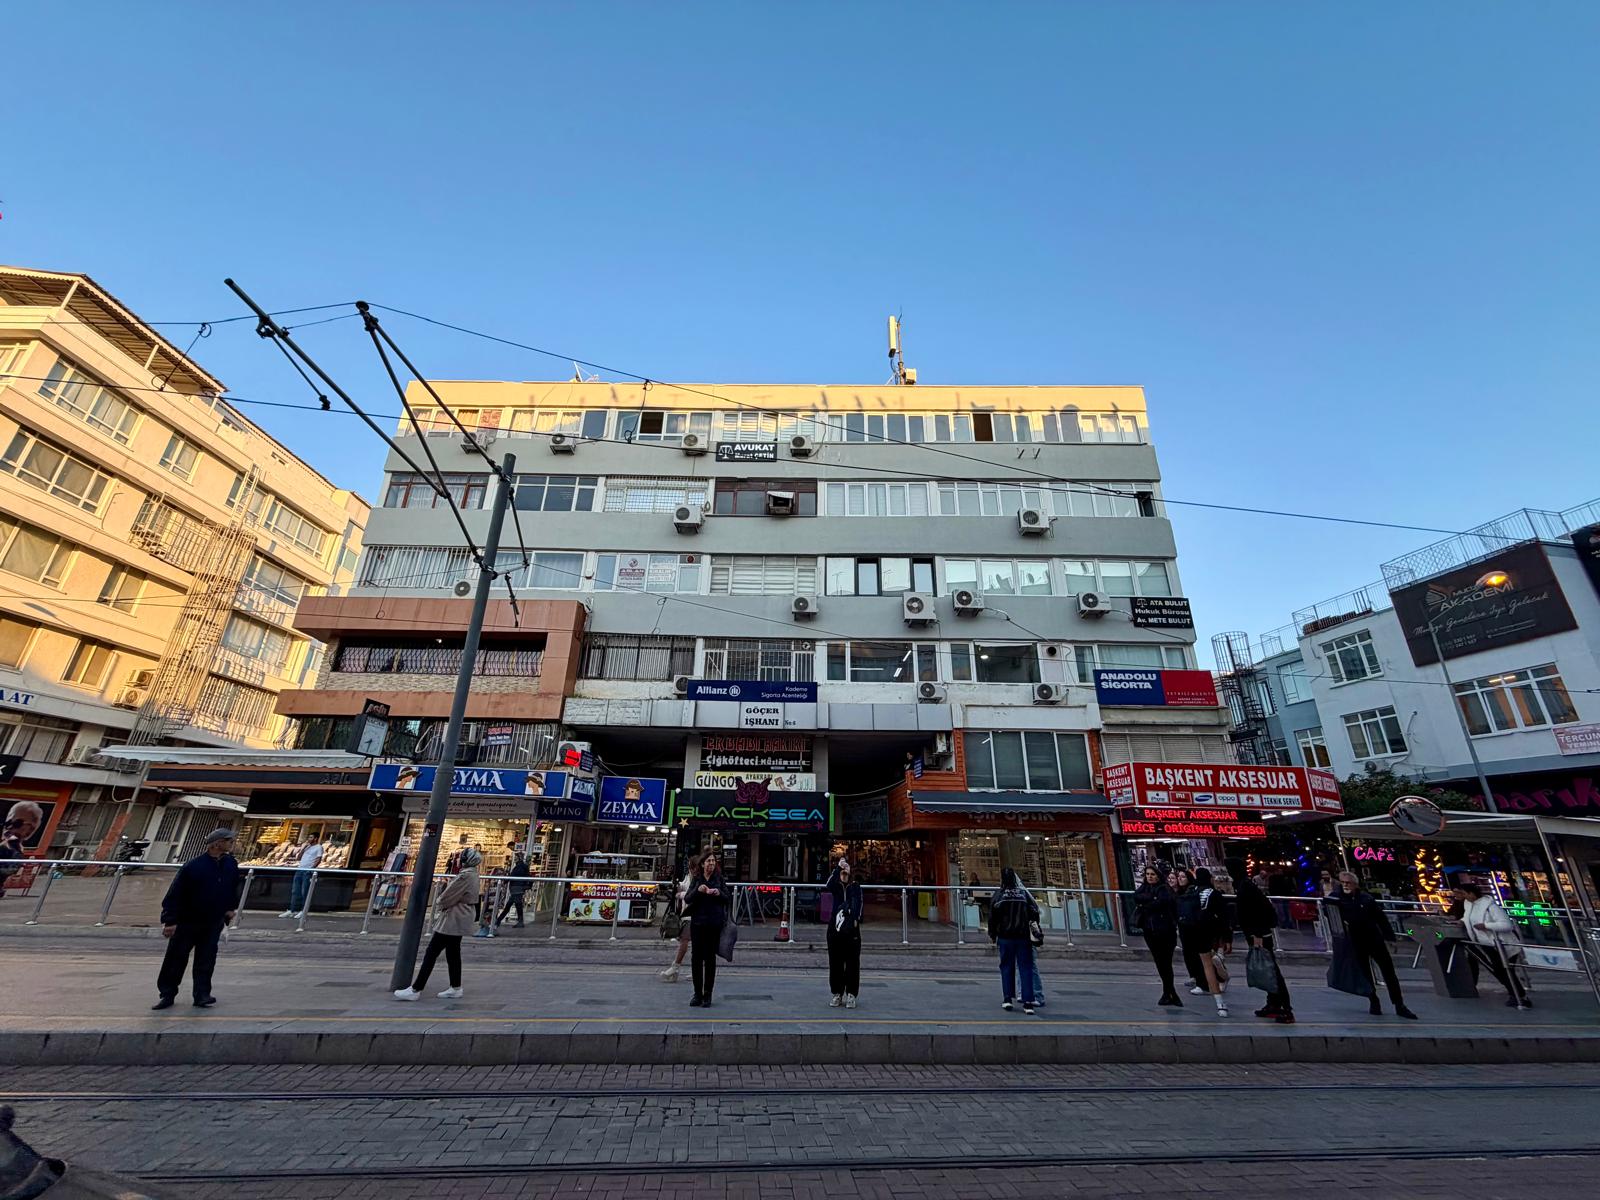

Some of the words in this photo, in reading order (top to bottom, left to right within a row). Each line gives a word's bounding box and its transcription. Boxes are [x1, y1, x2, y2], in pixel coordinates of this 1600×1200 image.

[1100, 672, 1156, 681] ANADOLU
[1101, 680, 1152, 689] SİGORTA
[696, 685, 728, 695] Allianz
[745, 706, 779, 715] GÖÇER
[745, 716, 779, 726] İŞHANI
[1144, 767, 1214, 790] BAŞKENT
[1219, 769, 1299, 790] AKSESUAR
[1264, 796, 1282, 805] TEKNİK
[1283, 797, 1300, 806] SERVİS
[541, 806, 582, 816] XUPING
[601, 800, 658, 819] ZEYMA
[1144, 809, 1187, 820] BAŞKENT
[1190, 810, 1238, 821] AKSESUAR
